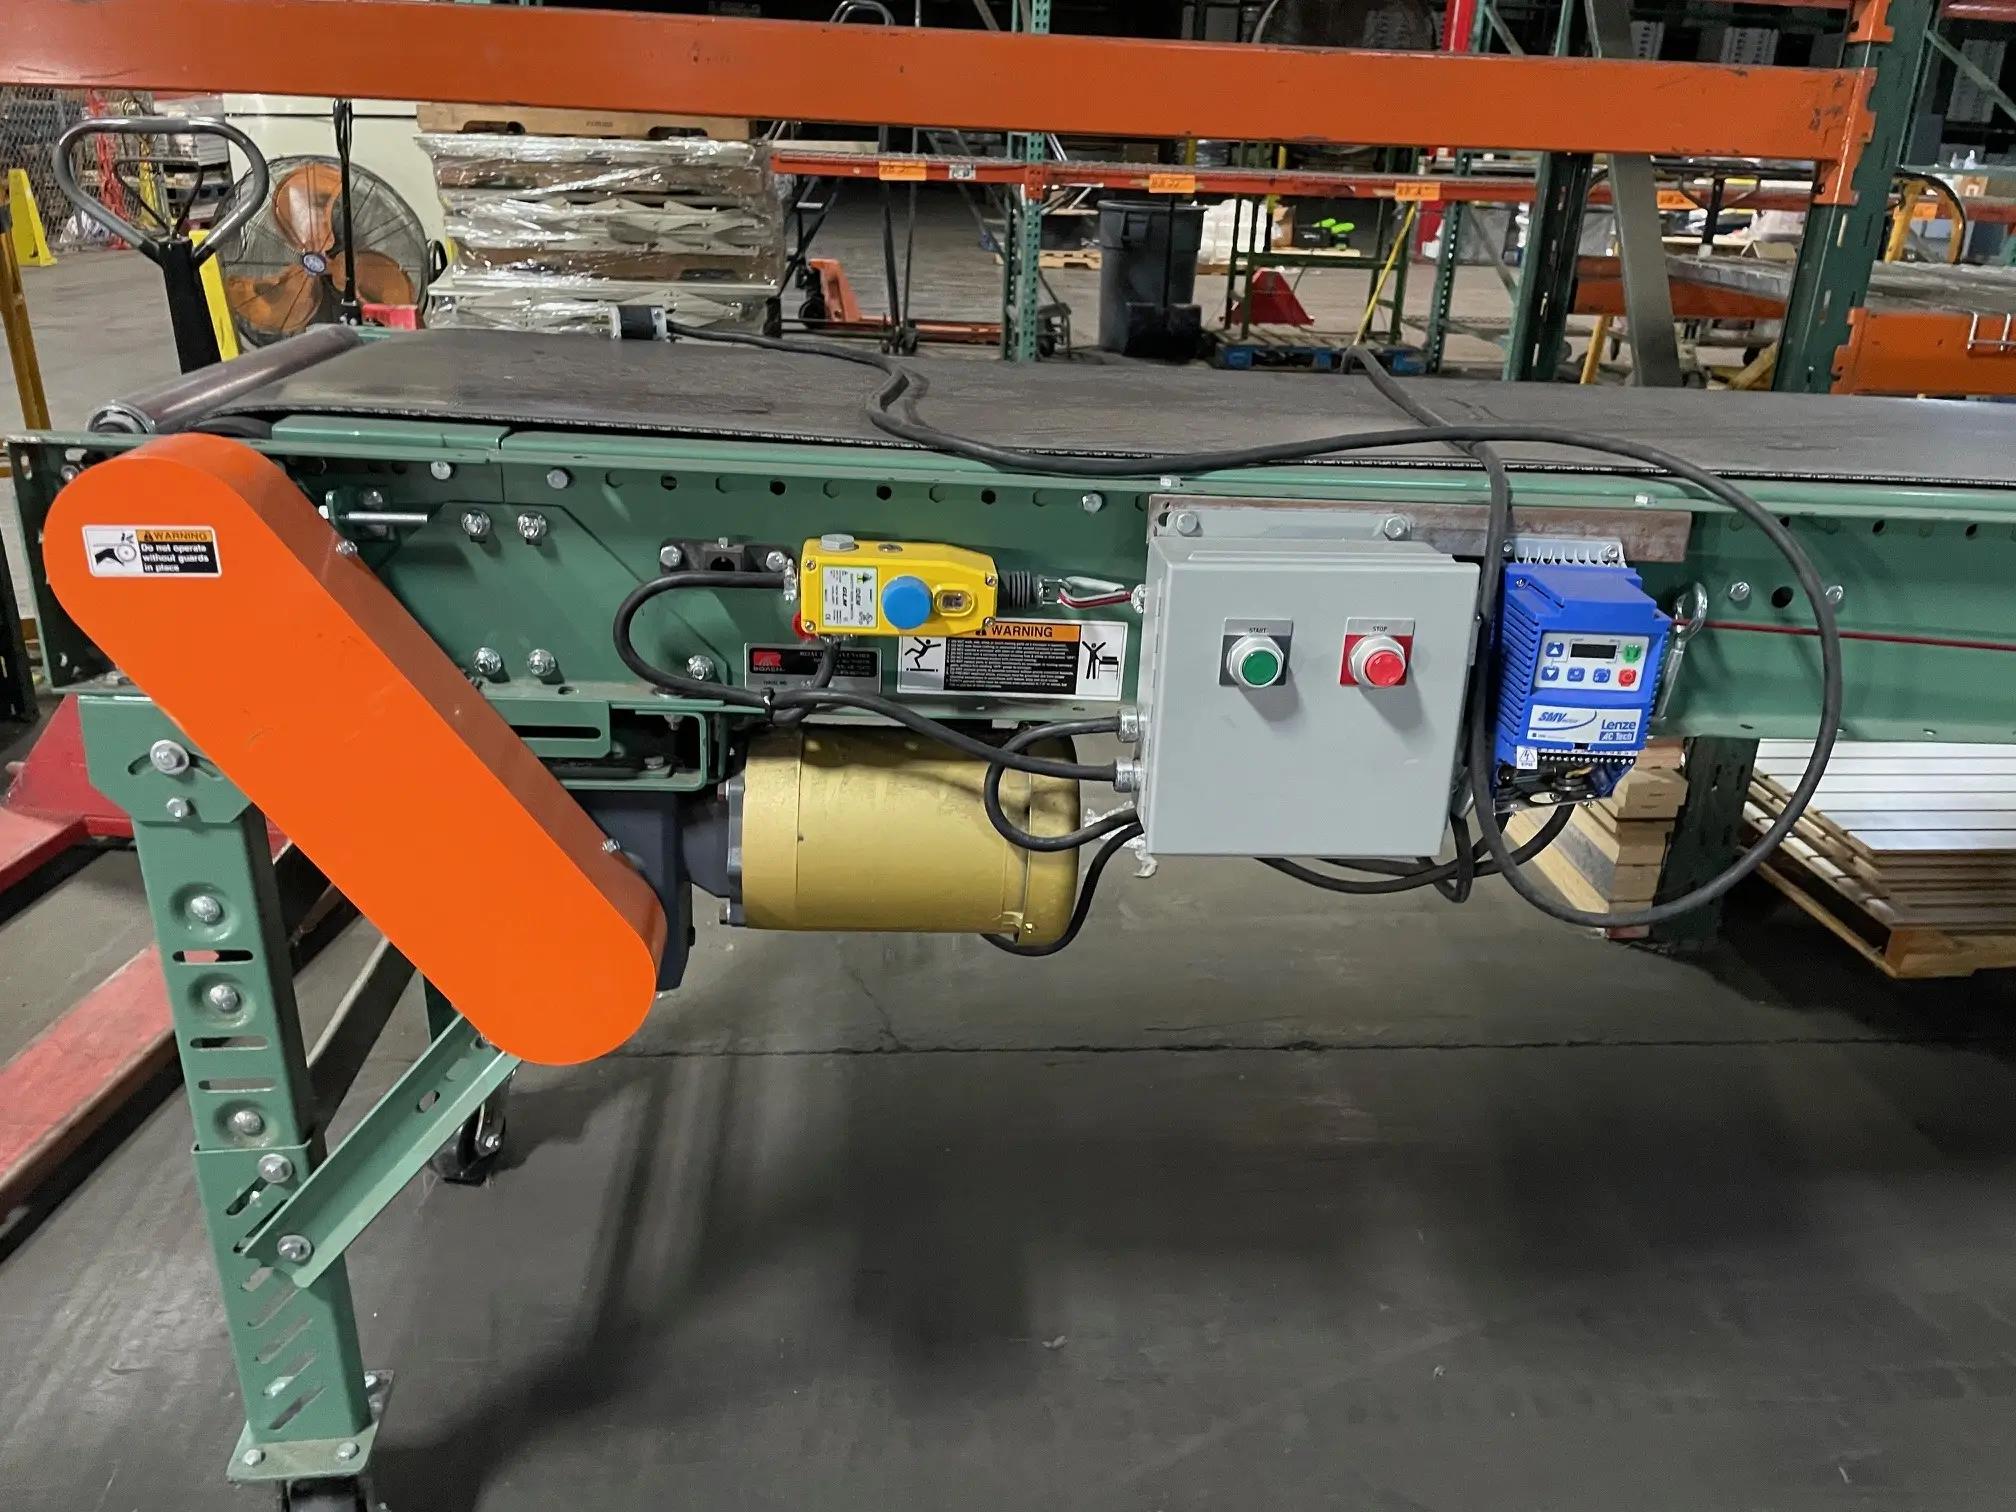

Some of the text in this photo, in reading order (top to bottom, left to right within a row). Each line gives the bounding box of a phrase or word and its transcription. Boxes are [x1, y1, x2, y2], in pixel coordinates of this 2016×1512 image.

[153, 532, 207, 540] WARNING
[141, 544, 206, 554] Do not operate
[142, 553, 209, 564] without guards
[144, 563, 179, 573] in place
[991, 625, 1053, 637] WARNING
[1538, 712, 1568, 722] SMV
[1602, 719, 1636, 730] Lenze
[1601, 733, 1632, 741] AC Tech
